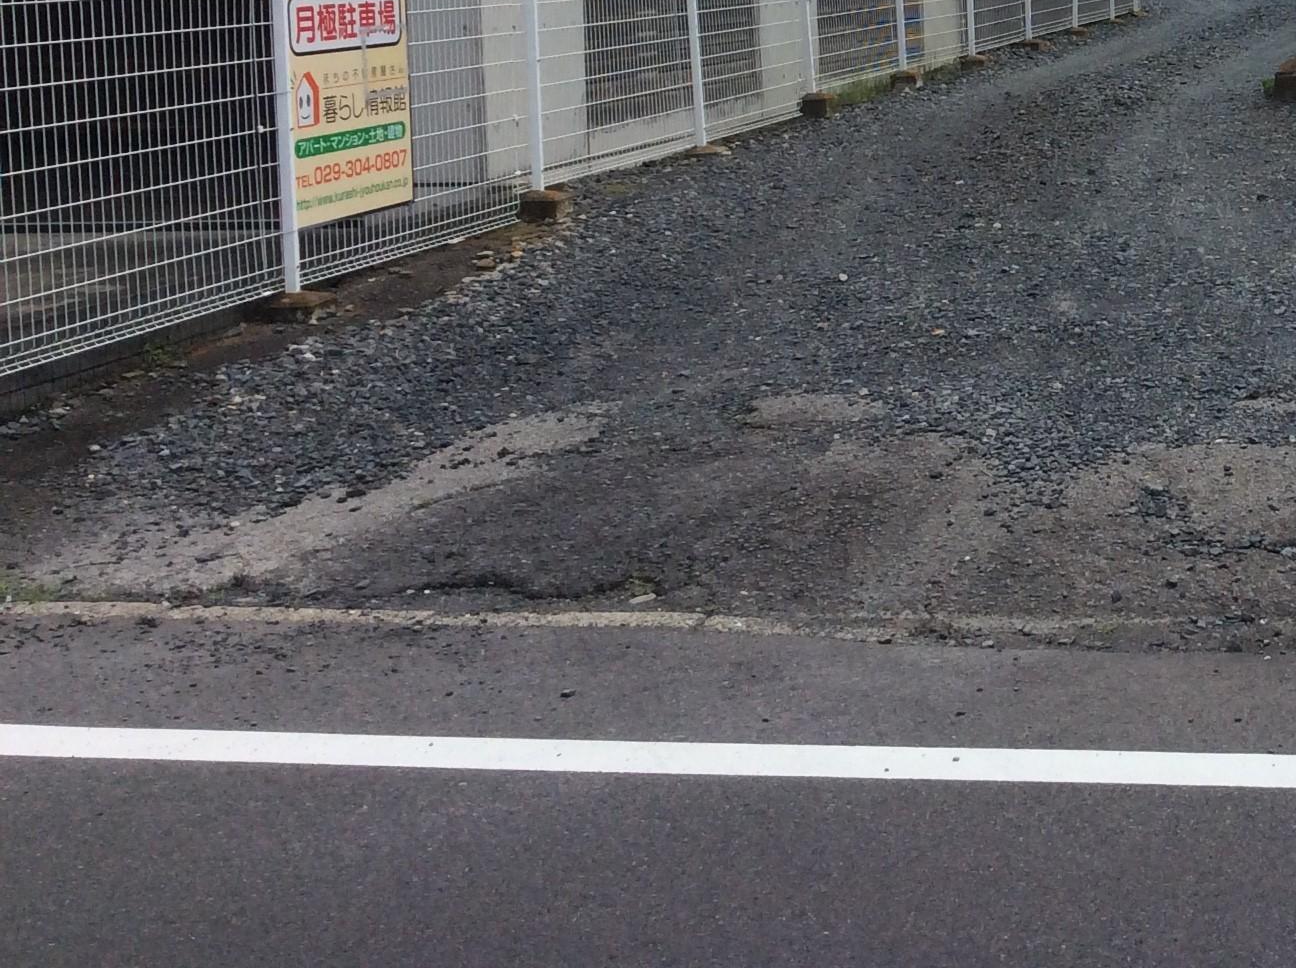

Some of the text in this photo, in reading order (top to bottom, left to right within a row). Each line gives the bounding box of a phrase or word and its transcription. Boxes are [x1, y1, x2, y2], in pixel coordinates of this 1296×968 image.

[296, 0, 396, 44] 月極駐車場
[314, 149, 407, 185] 029-304-0807
